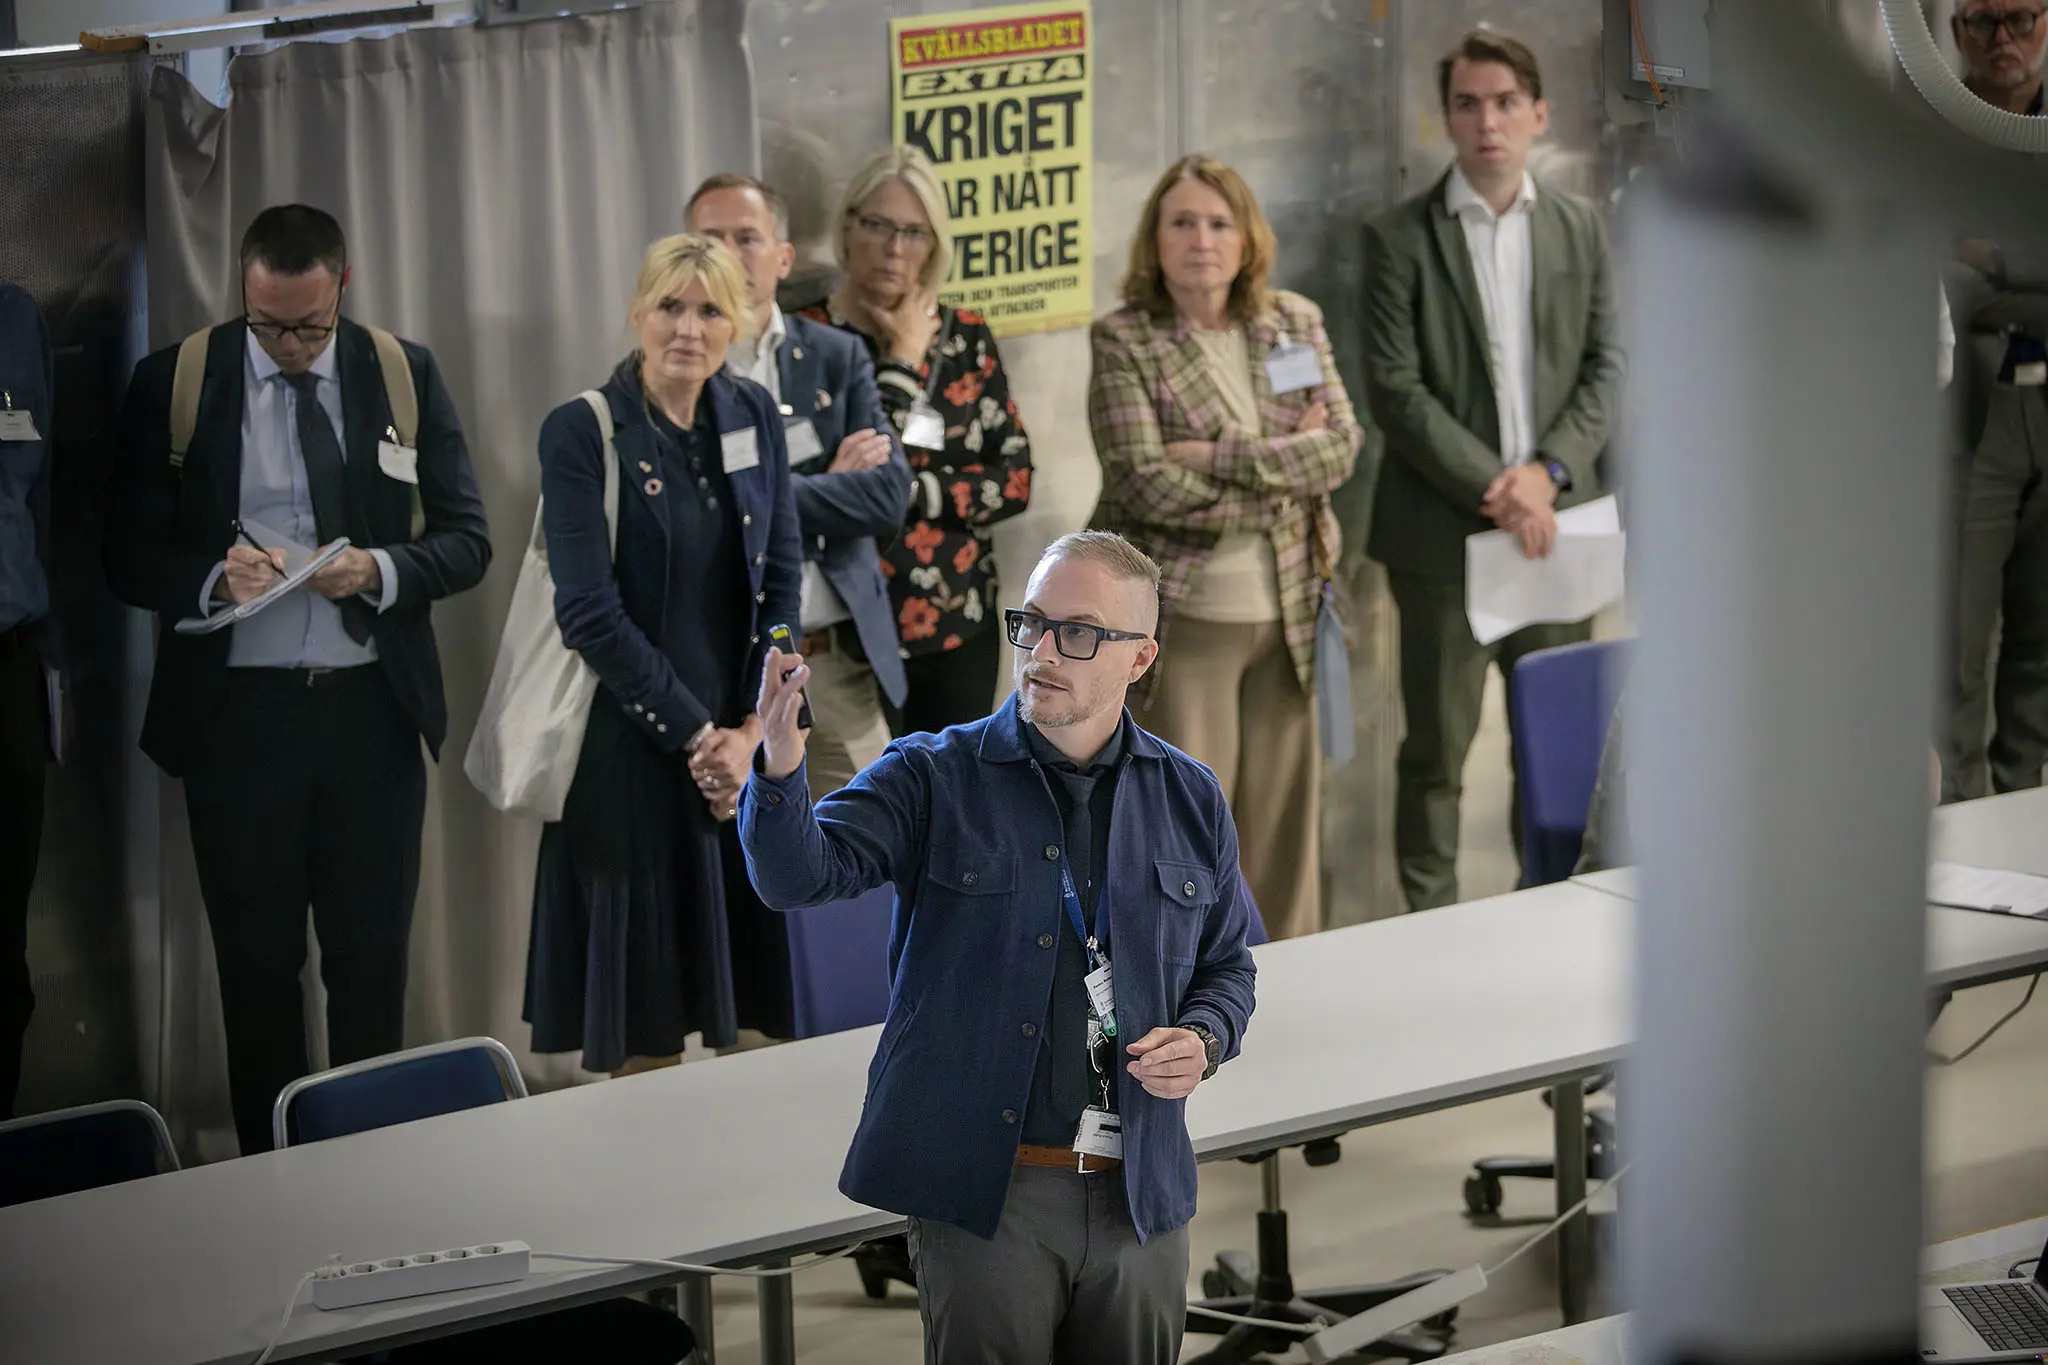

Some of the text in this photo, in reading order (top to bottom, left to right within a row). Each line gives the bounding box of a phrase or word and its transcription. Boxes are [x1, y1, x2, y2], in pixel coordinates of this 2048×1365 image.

[903, 18, 1081, 64] KVÄLLSBLADET
[904, 56, 1083, 97] EXTRA
[904, 91, 1084, 164] KRIGET
[993, 156, 1080, 214] NÅTT
[947, 220, 1079, 283] ERIGE
